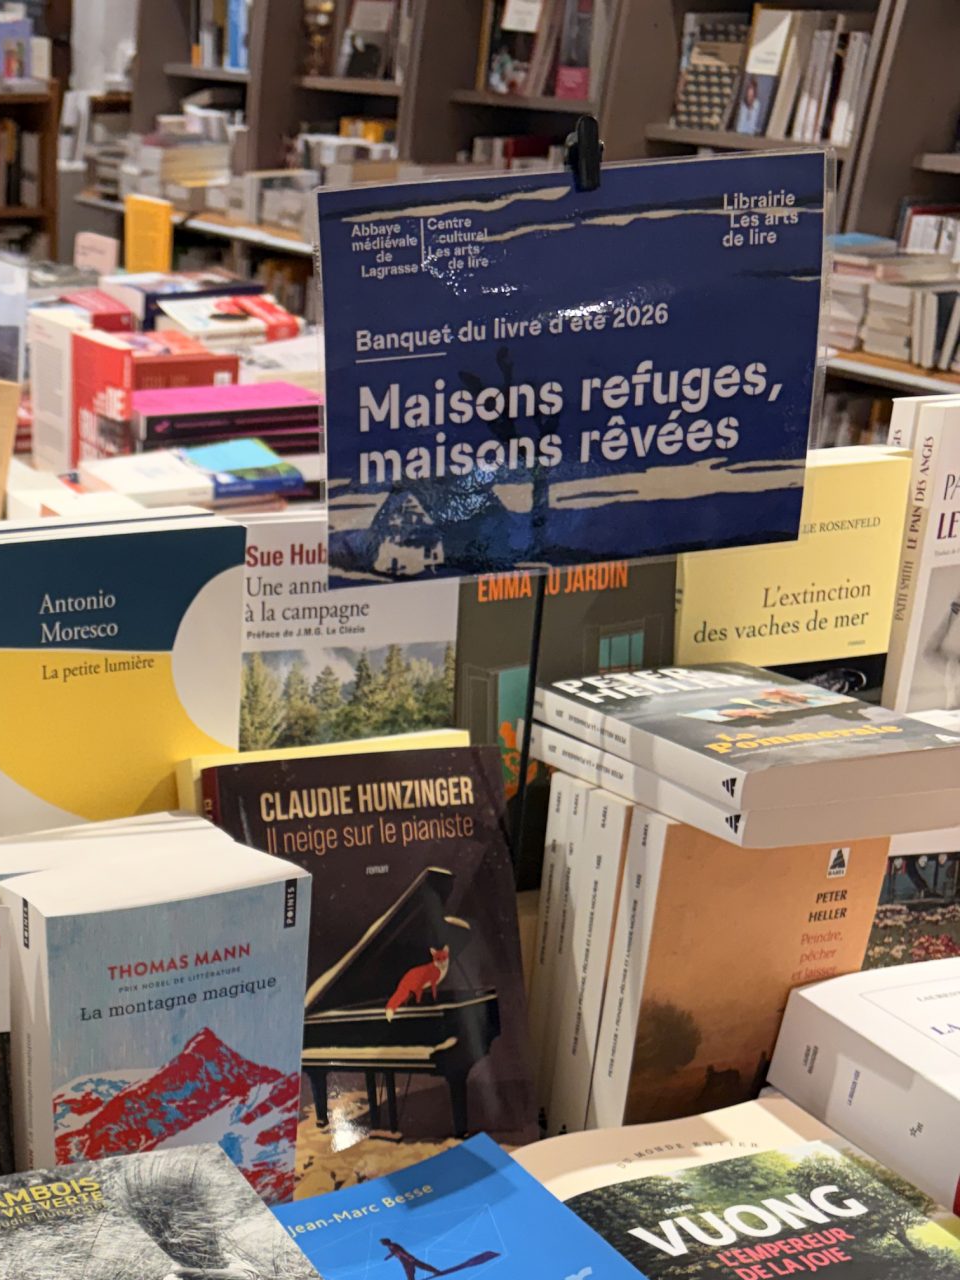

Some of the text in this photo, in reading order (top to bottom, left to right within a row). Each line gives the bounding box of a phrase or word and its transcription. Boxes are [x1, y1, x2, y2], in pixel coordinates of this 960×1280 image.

[723, 189, 796, 210] Librairie
[352, 222, 401, 238] Abbaye
[427, 216, 472, 230] Centre
[730, 210, 798, 228] Les arts
[352, 234, 418, 251] médiévale
[722, 228, 777, 247] de lire
[376, 252, 392, 263] de
[428, 243, 481, 258] Les arts
[448, 254, 489, 269] de lire
[361, 264, 418, 280] Lagrasse
[356, 325, 452, 352] Banquet
[458, 320, 486, 343] du
[494, 318, 541, 340] livre
[612, 303, 669, 328] 2026
[359, 360, 783, 432] Maisons refuges,
[359, 408, 740, 484] maisons rêvées
[919, 436, 934, 476] ANGES
[914, 479, 927, 502] DES
[819, 516, 881, 533] ROSENFELD
[909, 506, 922, 534] PAIN
[245, 545, 283, 567] Sue
[906, 538, 918, 550] LE
[246, 576, 283, 597] Une
[477, 561, 628, 603] EMMA JARDIN
[762, 578, 871, 609] L'extinction
[39, 590, 116, 616] Antonio
[245, 601, 370, 625] à la campagne
[40, 621, 119, 645] Moresco
[246, 629, 280, 640] Préface
[694, 610, 869, 644] des vaches de mer
[41, 655, 155, 683] La petite lumière
[260, 776, 474, 822] CLAUDIE HUNZINGER
[267, 812, 474, 856] Il neige sur le pianiste
[816, 889, 848, 904] PETER
[808, 907, 847, 923] HELLER
[107, 943, 251, 981] THOMAS MANN
[80, 975, 277, 1022] La montagne magique
[287, 1183, 434, 1239] Jean-Marc Besse
[627, 1185, 869, 1258] VUONG
[716, 1227, 855, 1268] L'EMPEREUR
